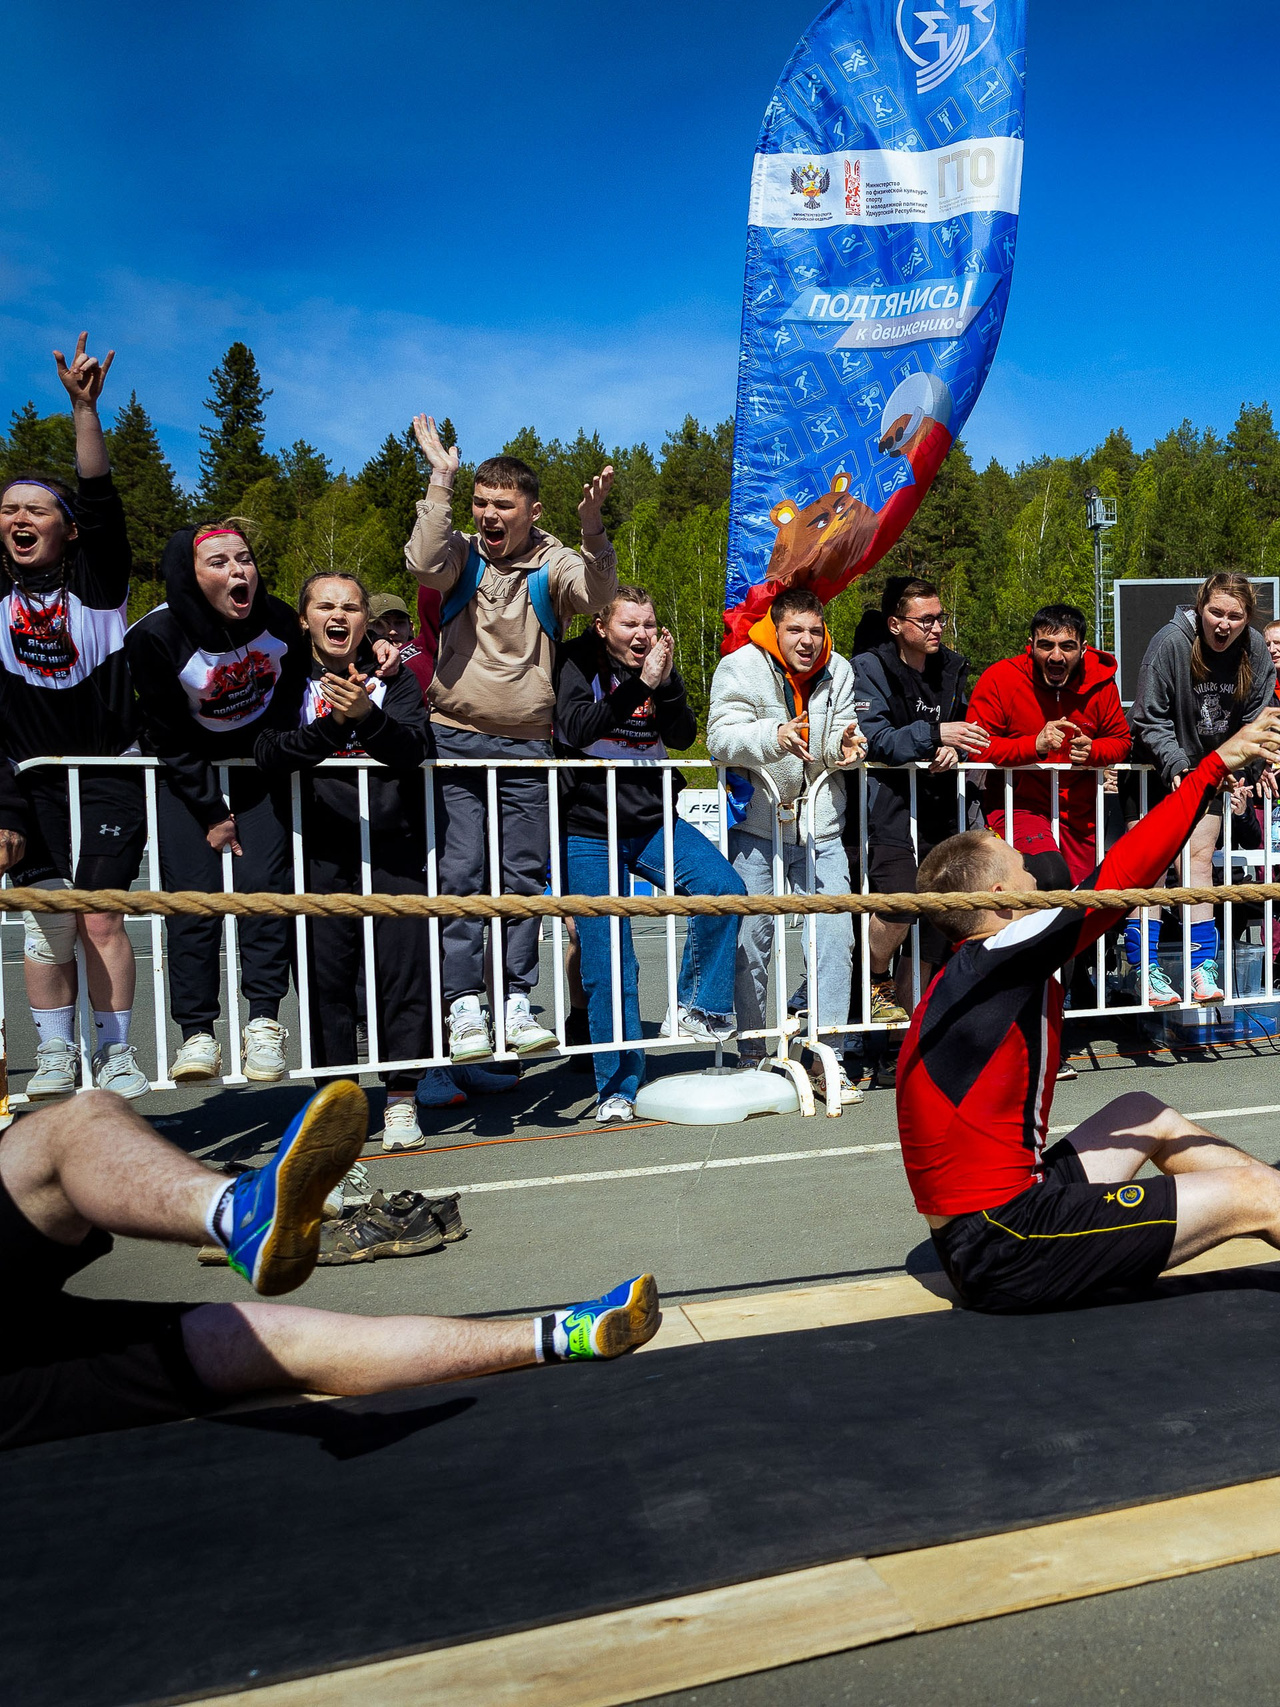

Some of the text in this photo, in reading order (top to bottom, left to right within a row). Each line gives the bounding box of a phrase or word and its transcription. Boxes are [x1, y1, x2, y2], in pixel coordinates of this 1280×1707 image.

[938, 147, 995, 198] ГТО
[873, 187, 903, 196] физической
[855, 328, 867, 341] к
